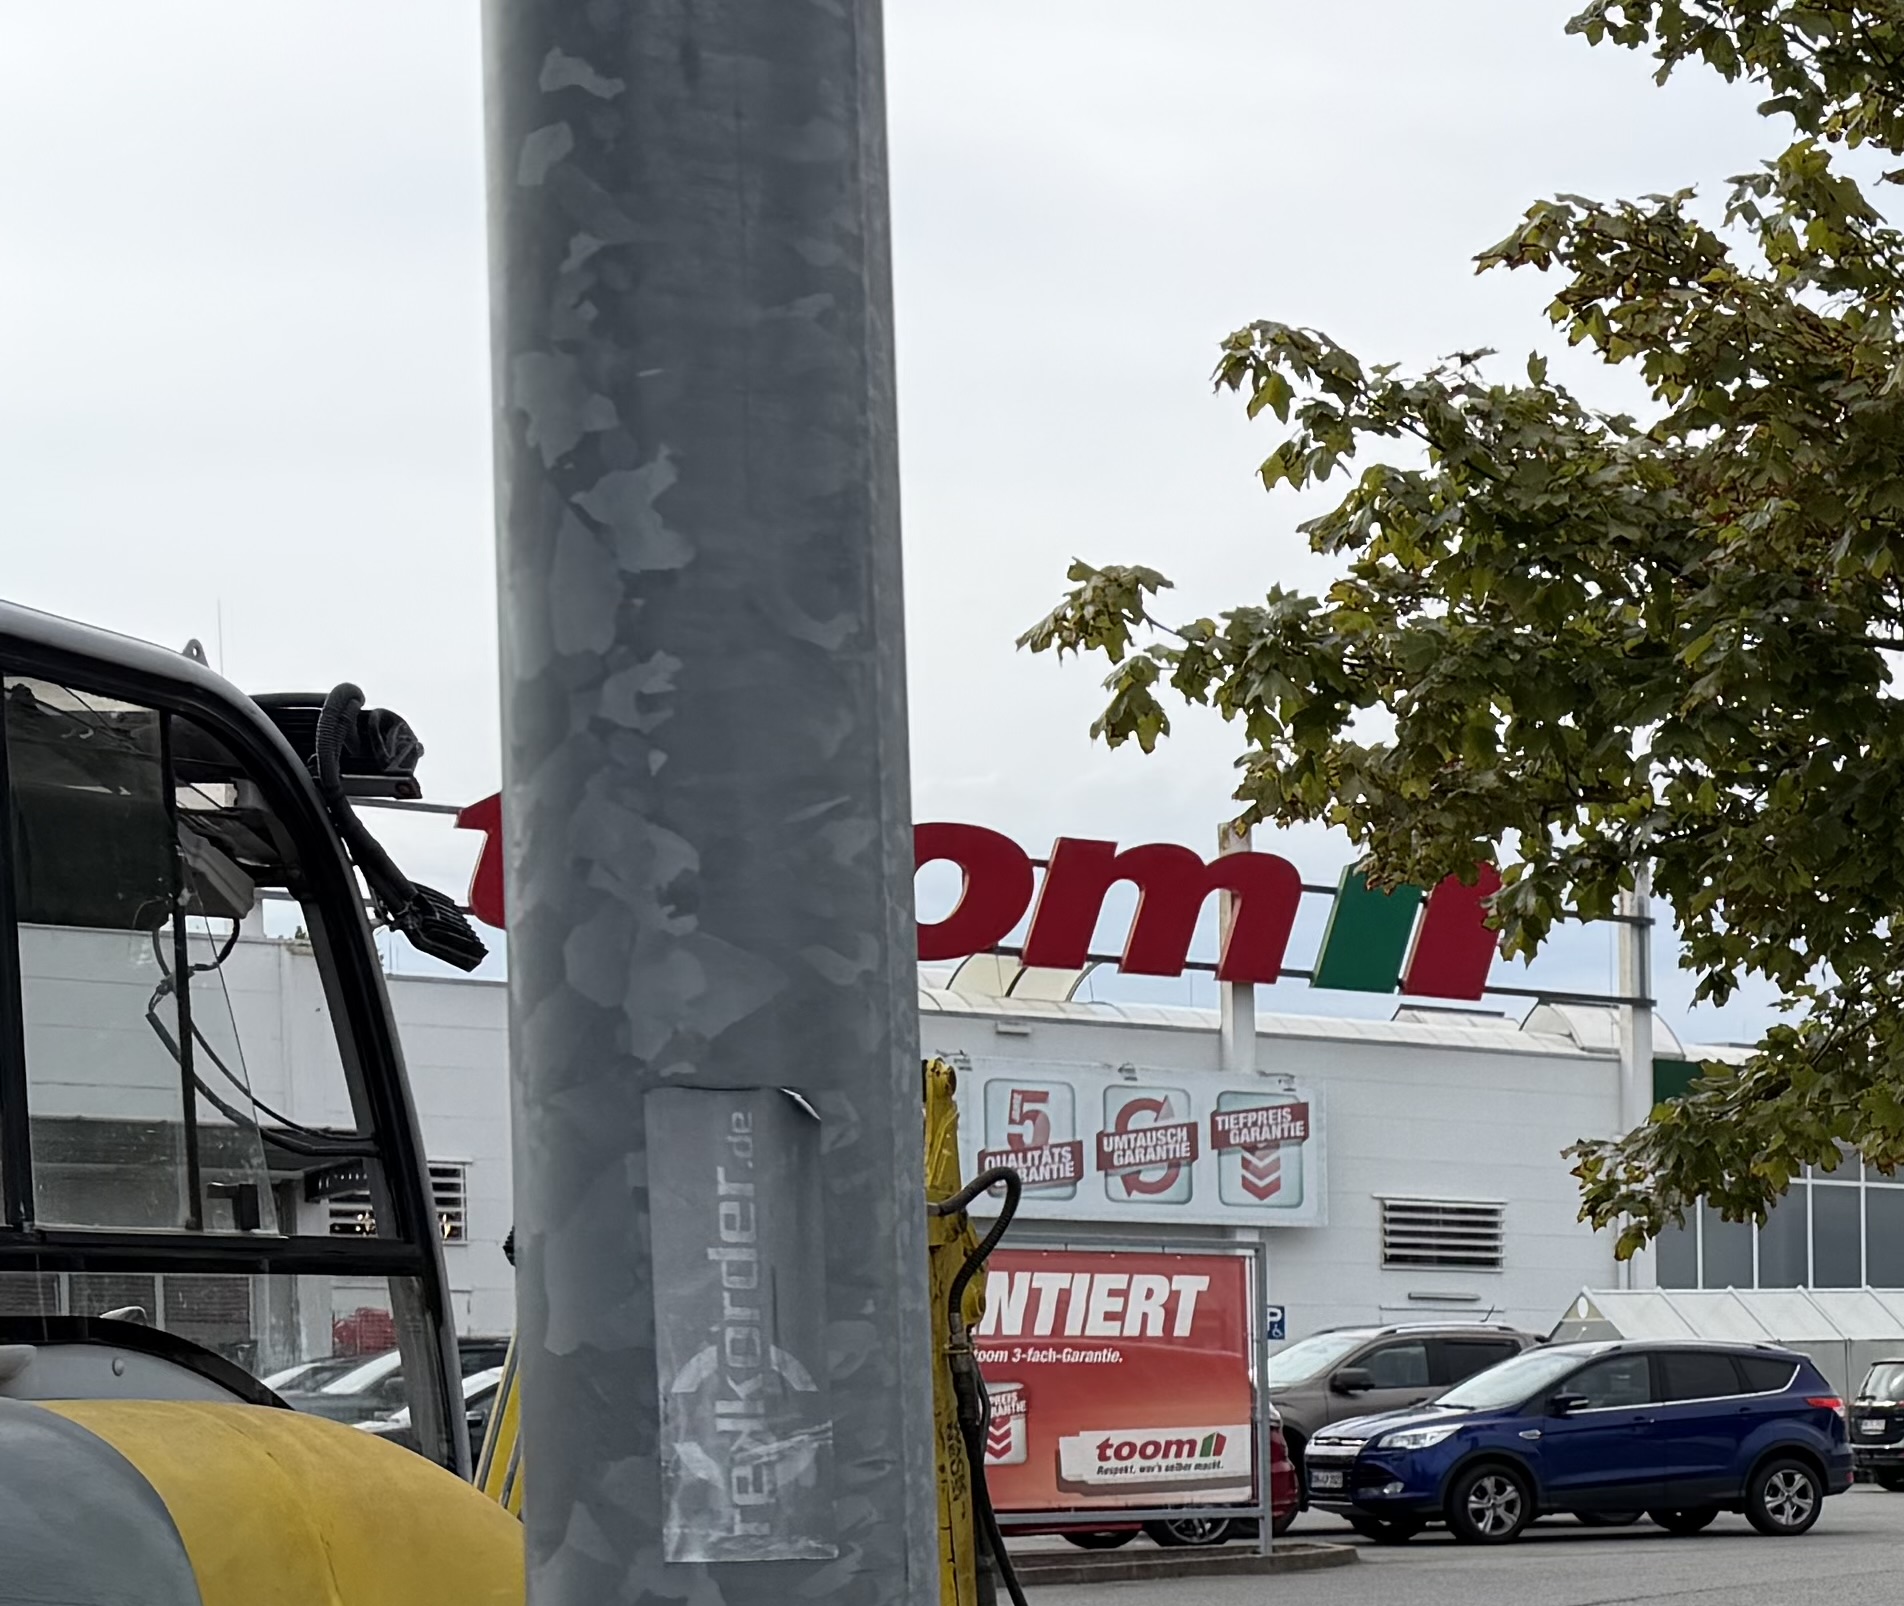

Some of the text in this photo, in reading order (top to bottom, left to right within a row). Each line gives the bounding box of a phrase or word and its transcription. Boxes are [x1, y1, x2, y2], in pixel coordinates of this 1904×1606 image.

[1007, 1088, 1051, 1151] 5
[1215, 1107, 1293, 1130] TIEFPREIS
[1229, 1118, 1305, 1144] GARANTIE
[1102, 1128, 1188, 1152] UMTAUSCH
[984, 1145, 1072, 1171] QUALITÄTS
[1112, 1142, 1191, 1167] GARANTIE
[974, 1271, 1210, 1337] NTIERT
[1012, 1346, 1124, 1364] 3-fach-Garantie.
[1096, 1436, 1198, 1462] toom
